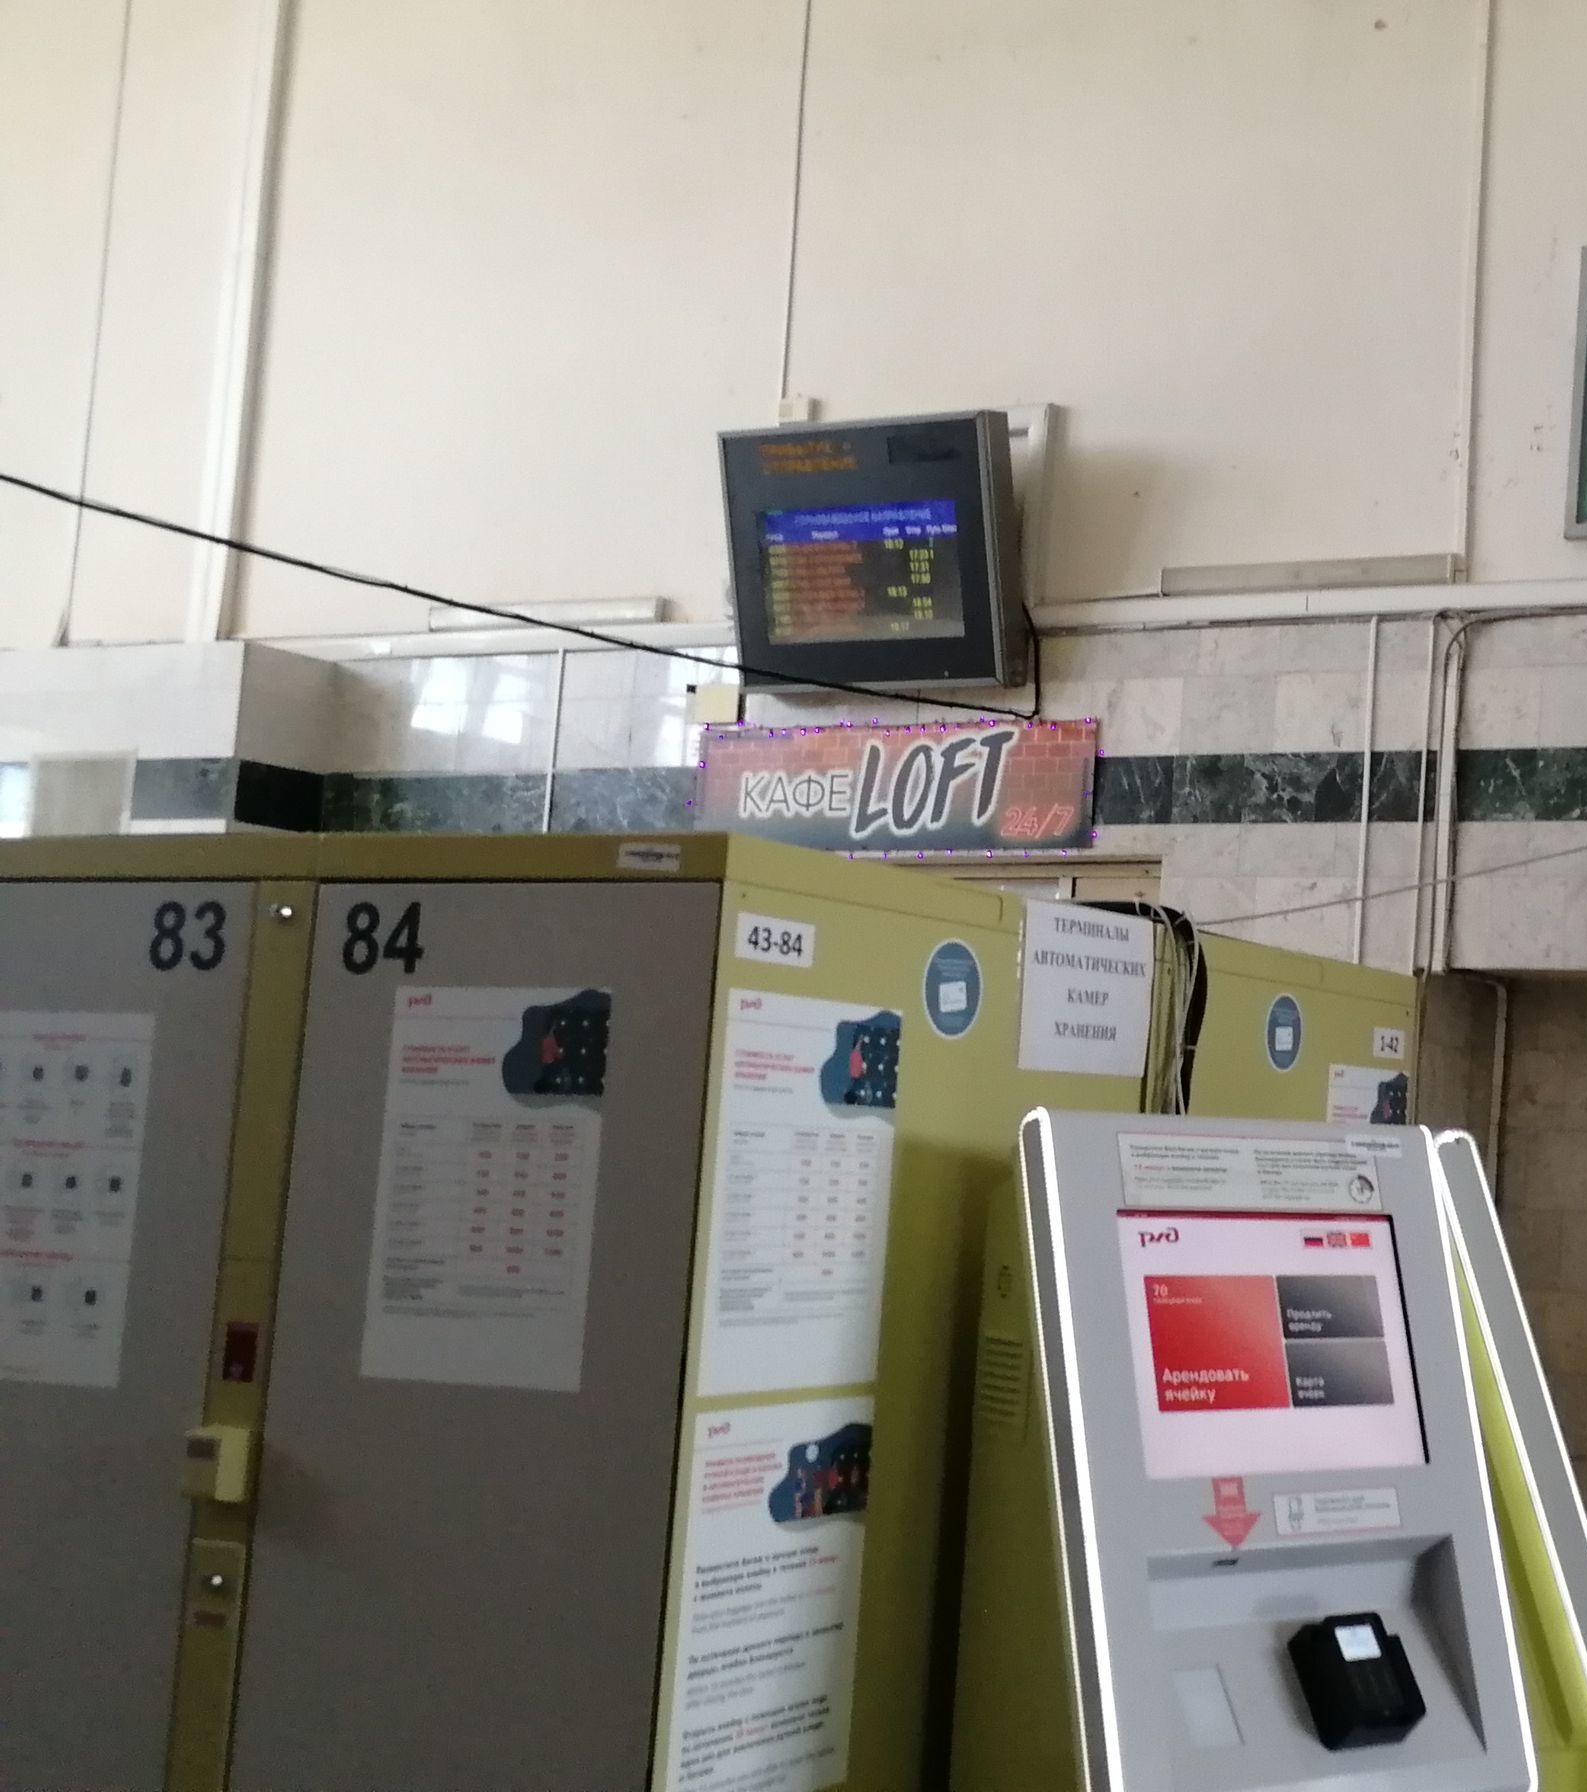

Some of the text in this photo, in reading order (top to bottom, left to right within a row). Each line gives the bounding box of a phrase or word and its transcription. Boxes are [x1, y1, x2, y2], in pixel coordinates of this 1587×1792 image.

[743, 731, 1074, 838] КАФЕ LOFT 24/7
[149, 900, 424, 975] 83 84
[748, 926, 803, 957] 43-84
[1054, 917, 1129, 942] ТЕРМИНАЛЫ
[1033, 949, 1146, 977] АВТОМАТИЧЕСКИХ
[1067, 988, 1109, 1006] КАМЕР
[1055, 1021, 1117, 1041] ХРАНЕНИЯ
[1162, 1367, 1249, 1385] Арендовать
[1164, 1386, 1216, 1404] ячейку
